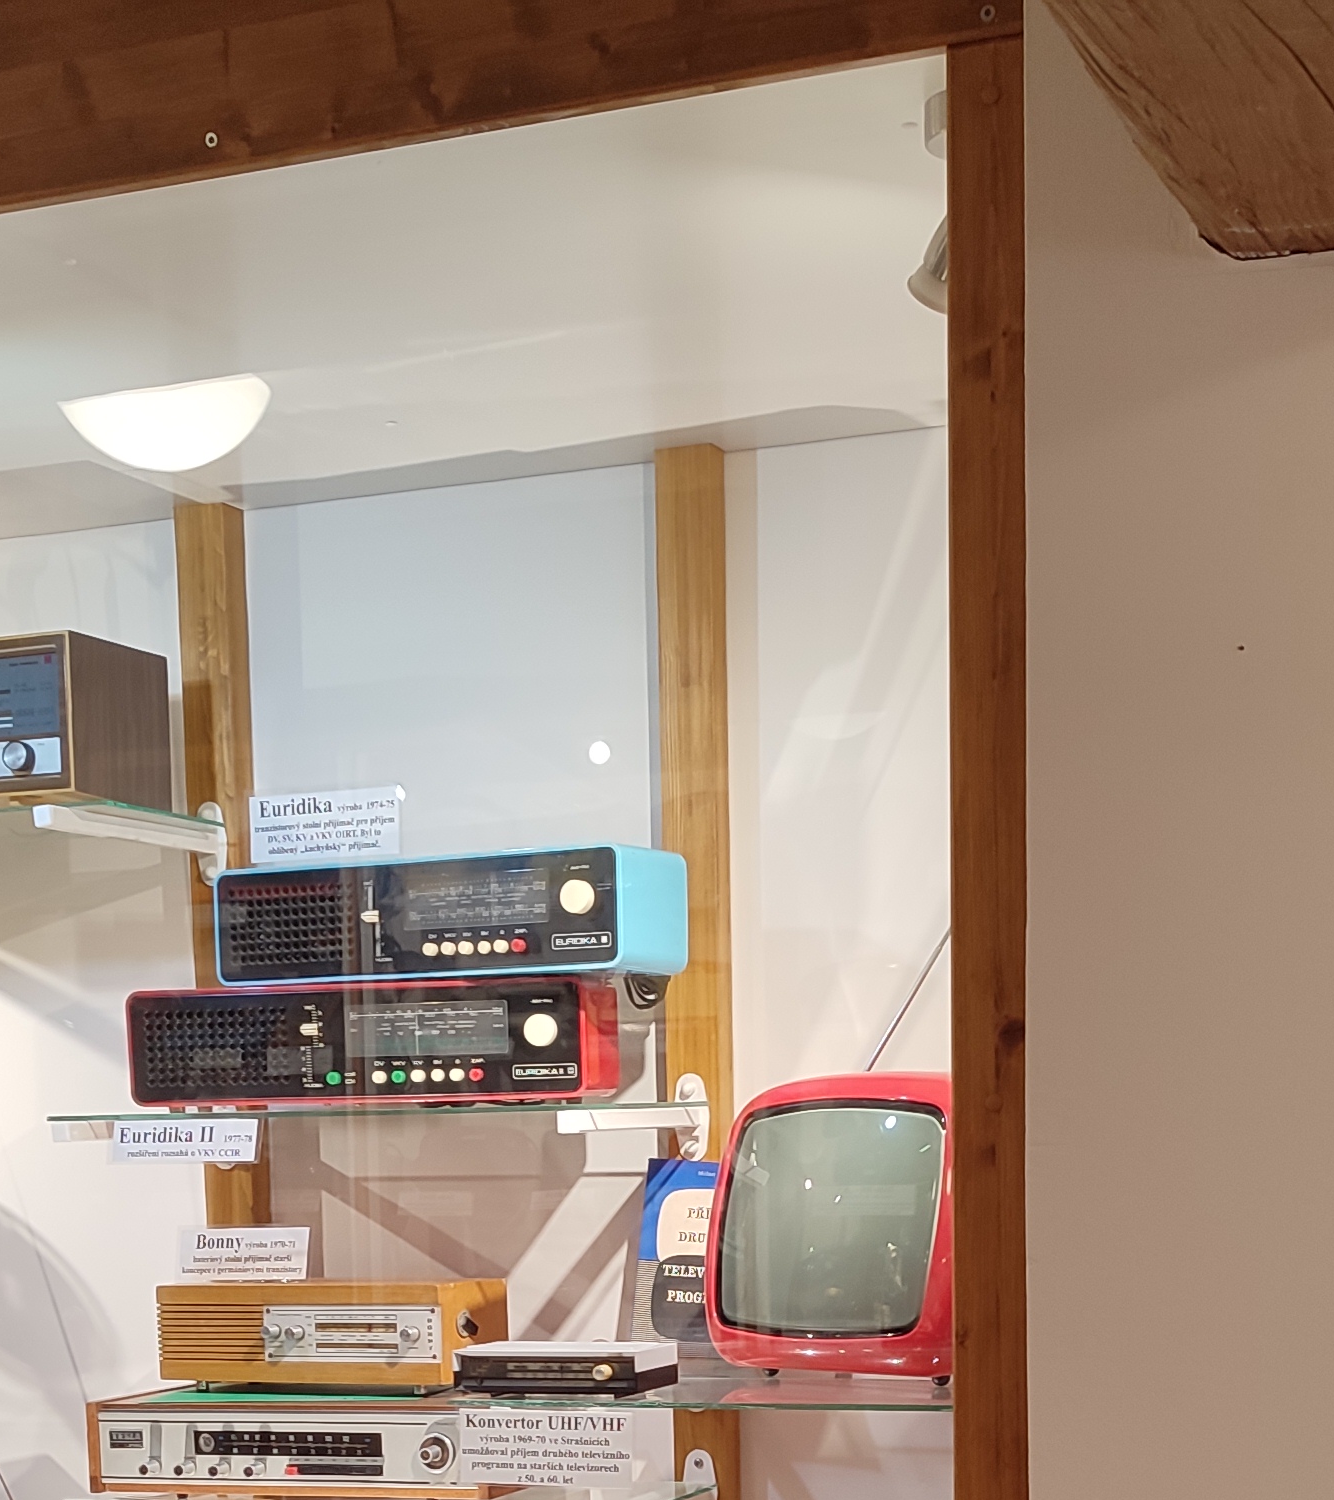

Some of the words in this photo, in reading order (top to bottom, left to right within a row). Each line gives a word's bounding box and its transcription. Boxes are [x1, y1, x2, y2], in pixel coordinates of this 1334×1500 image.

[260, 798, 332, 818] Euridika
[337, 804, 362, 816] výroba
[366, 800, 395, 809] 1974-75
[356, 819, 368, 827] pro
[555, 936, 597, 945] EURIDIKA
[120, 1127, 193, 1144] Euridika
[200, 1126, 214, 1142] II
[224, 1135, 252, 1143] 1977-78
[678, 1232, 706, 1242] DRU
[196, 1234, 243, 1253] Bonny
[245, 1242, 268, 1250] výroba
[662, 1265, 705, 1278] TELEV
[667, 1290, 706, 1303] PROG
[465, 1414, 542, 1430] Konvertor
[548, 1415, 626, 1431] UHF/VHF
[479, 1436, 509, 1445] výroba
[513, 1436, 546, 1445] 1969-70
[561, 1437, 610, 1446] Strašnicích
[462, 1448, 507, 1456] umožňoval
[511, 1448, 539, 1458] příjem
[542, 1449, 579, 1458] druhého
[582, 1451, 630, 1460] televizního
[472, 1461, 514, 1470] programu
[517, 1462, 527, 1470] na
[530, 1462, 563, 1471] starších
[567, 1463, 619, 1473] televizorech
[563, 1476, 573, 1484] let
